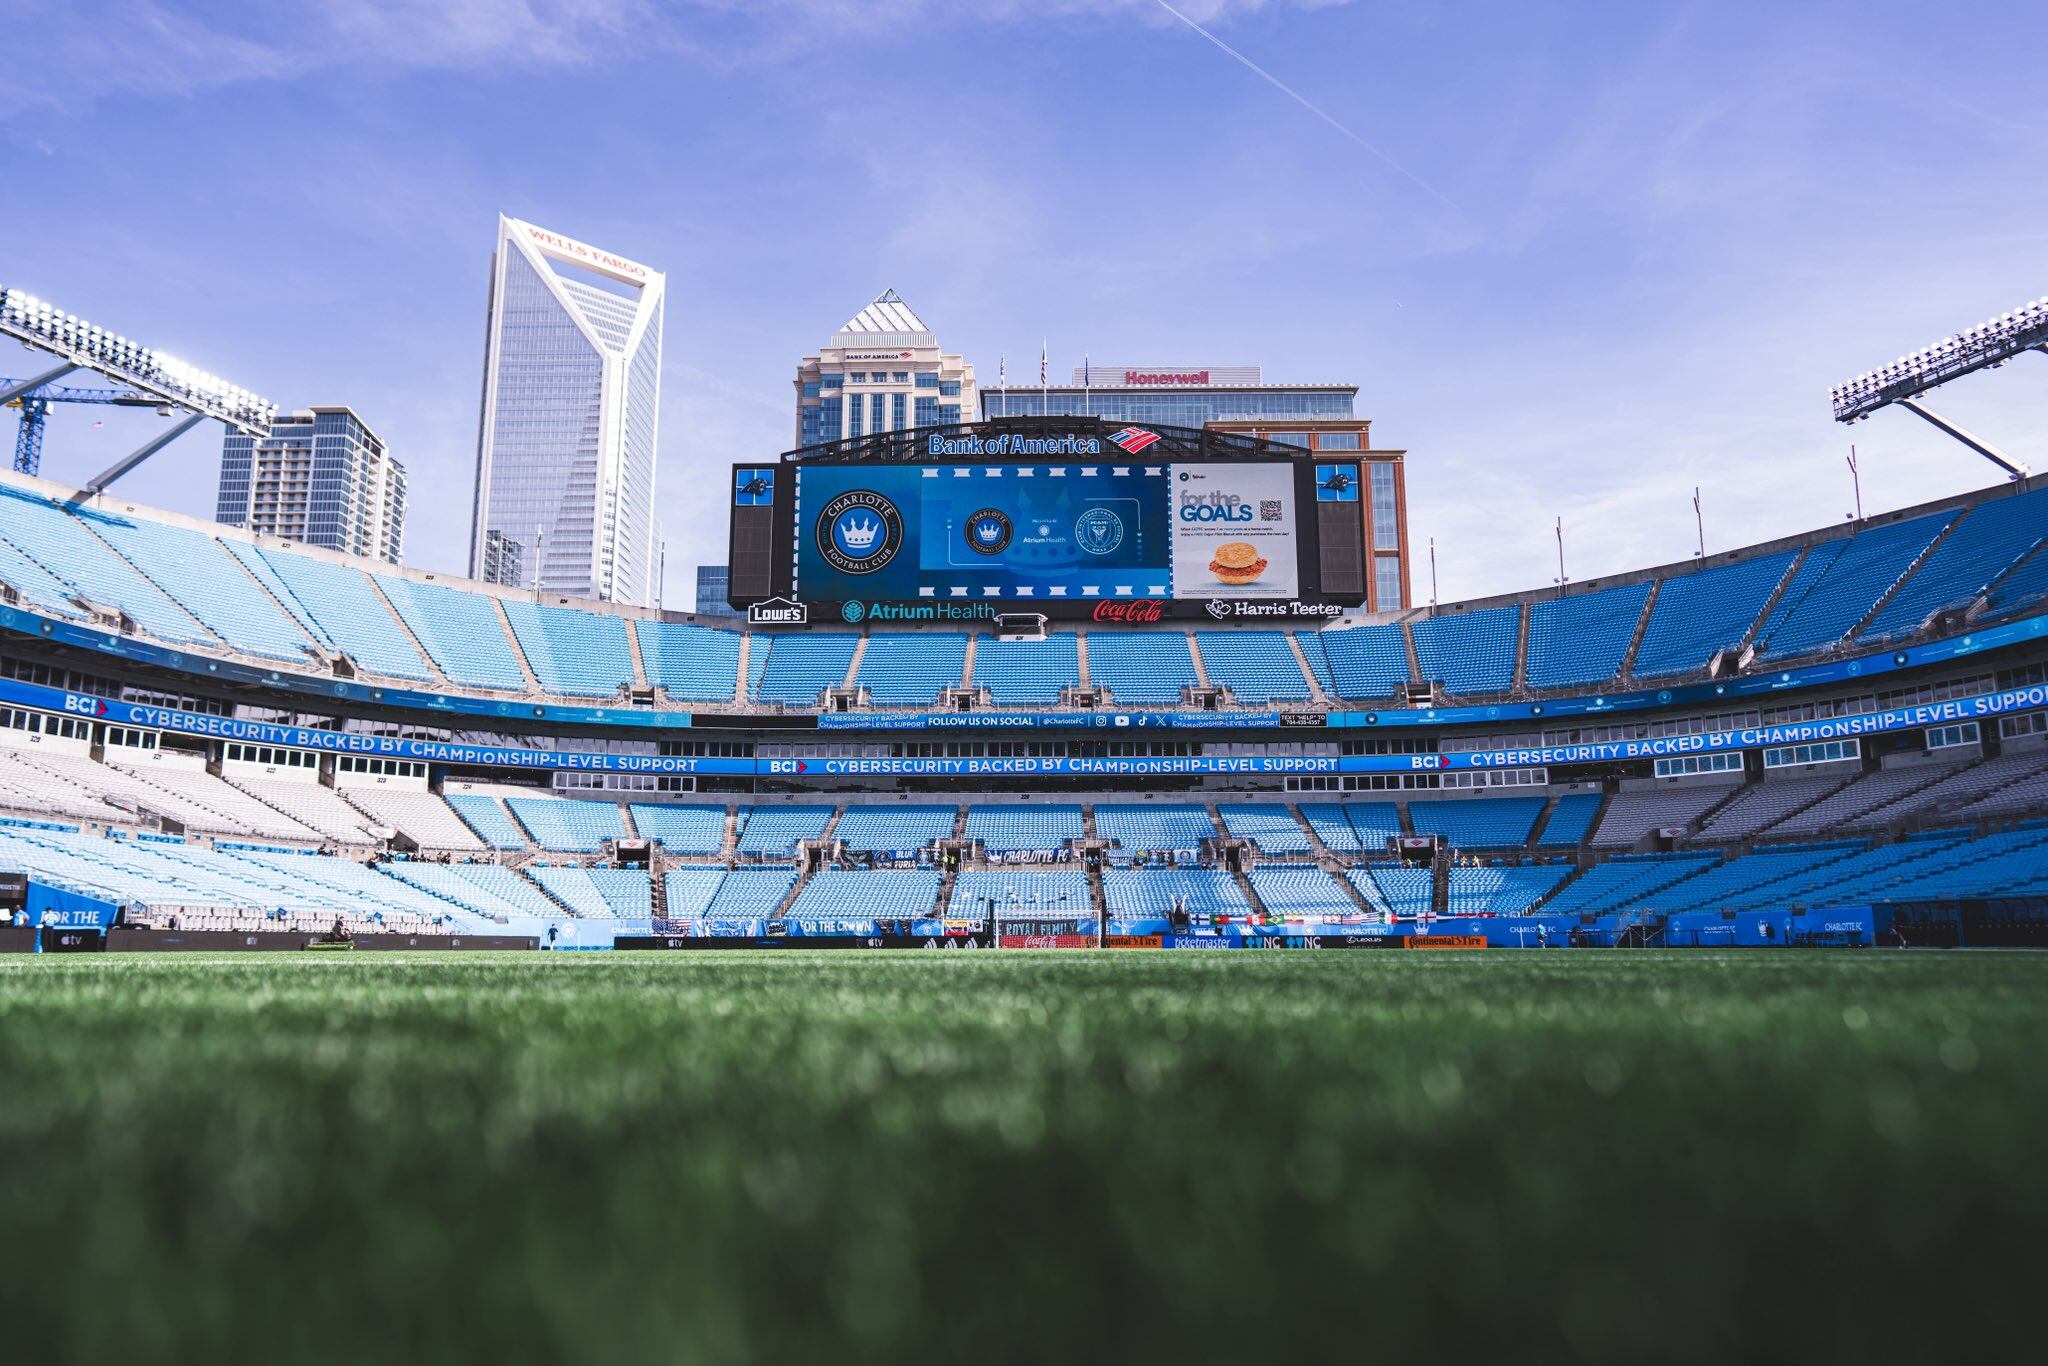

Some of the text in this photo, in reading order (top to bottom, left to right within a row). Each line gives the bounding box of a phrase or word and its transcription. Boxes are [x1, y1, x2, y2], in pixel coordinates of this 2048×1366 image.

[529, 229, 646, 276] WELLS FARGO
[1125, 370, 1209, 385] Honeywell
[929, 434, 1100, 455] Bank of America
[1180, 489, 1240, 506] for the
[828, 494, 894, 517] CHARLOTTE
[1180, 504, 1253, 521] GOALS
[827, 548, 892, 570] FOOTBALL CLUB
[754, 607, 801, 621] LOWE'S
[869, 603, 995, 620] Atrium Health
[1234, 602, 1343, 615] Harris Teeter
[928, 717, 1033, 726] FOLLOW US ON SOCIAL
[1043, 717, 1084, 725] @CharlotteFC
[1411, 685, 2048, 768] BCI CYBERSECURITY BACKED BY CHAMPIONSHIP-LEVEL SUPPO
[65, 694, 698, 772] BCI CYBERSECURITY BACKED BY CHAMPIONSHIP-LEVEL SUPPORT
[771, 758, 1338, 774] BCI CYBERSECURITY BACKED BY CHAMPIONSHIP-LEVEL SUPPORT
[896, 850, 915, 859] BLUE
[1003, 849, 1069, 862] CHARLOTTE FC
[73, 911, 99, 924] THE
[800, 920, 816, 932] FOR
[819, 920, 835, 932] THE
[1341, 927, 1378, 935] CHARLOTTE
[1825, 922, 1863, 931] CHARLOTTE FC
[1175, 936, 1231, 948] ticketmaster
[1263, 937, 1281, 948] NC
[1304, 937, 1321, 948] NC
[1409, 936, 1480, 948] Continental Tire
